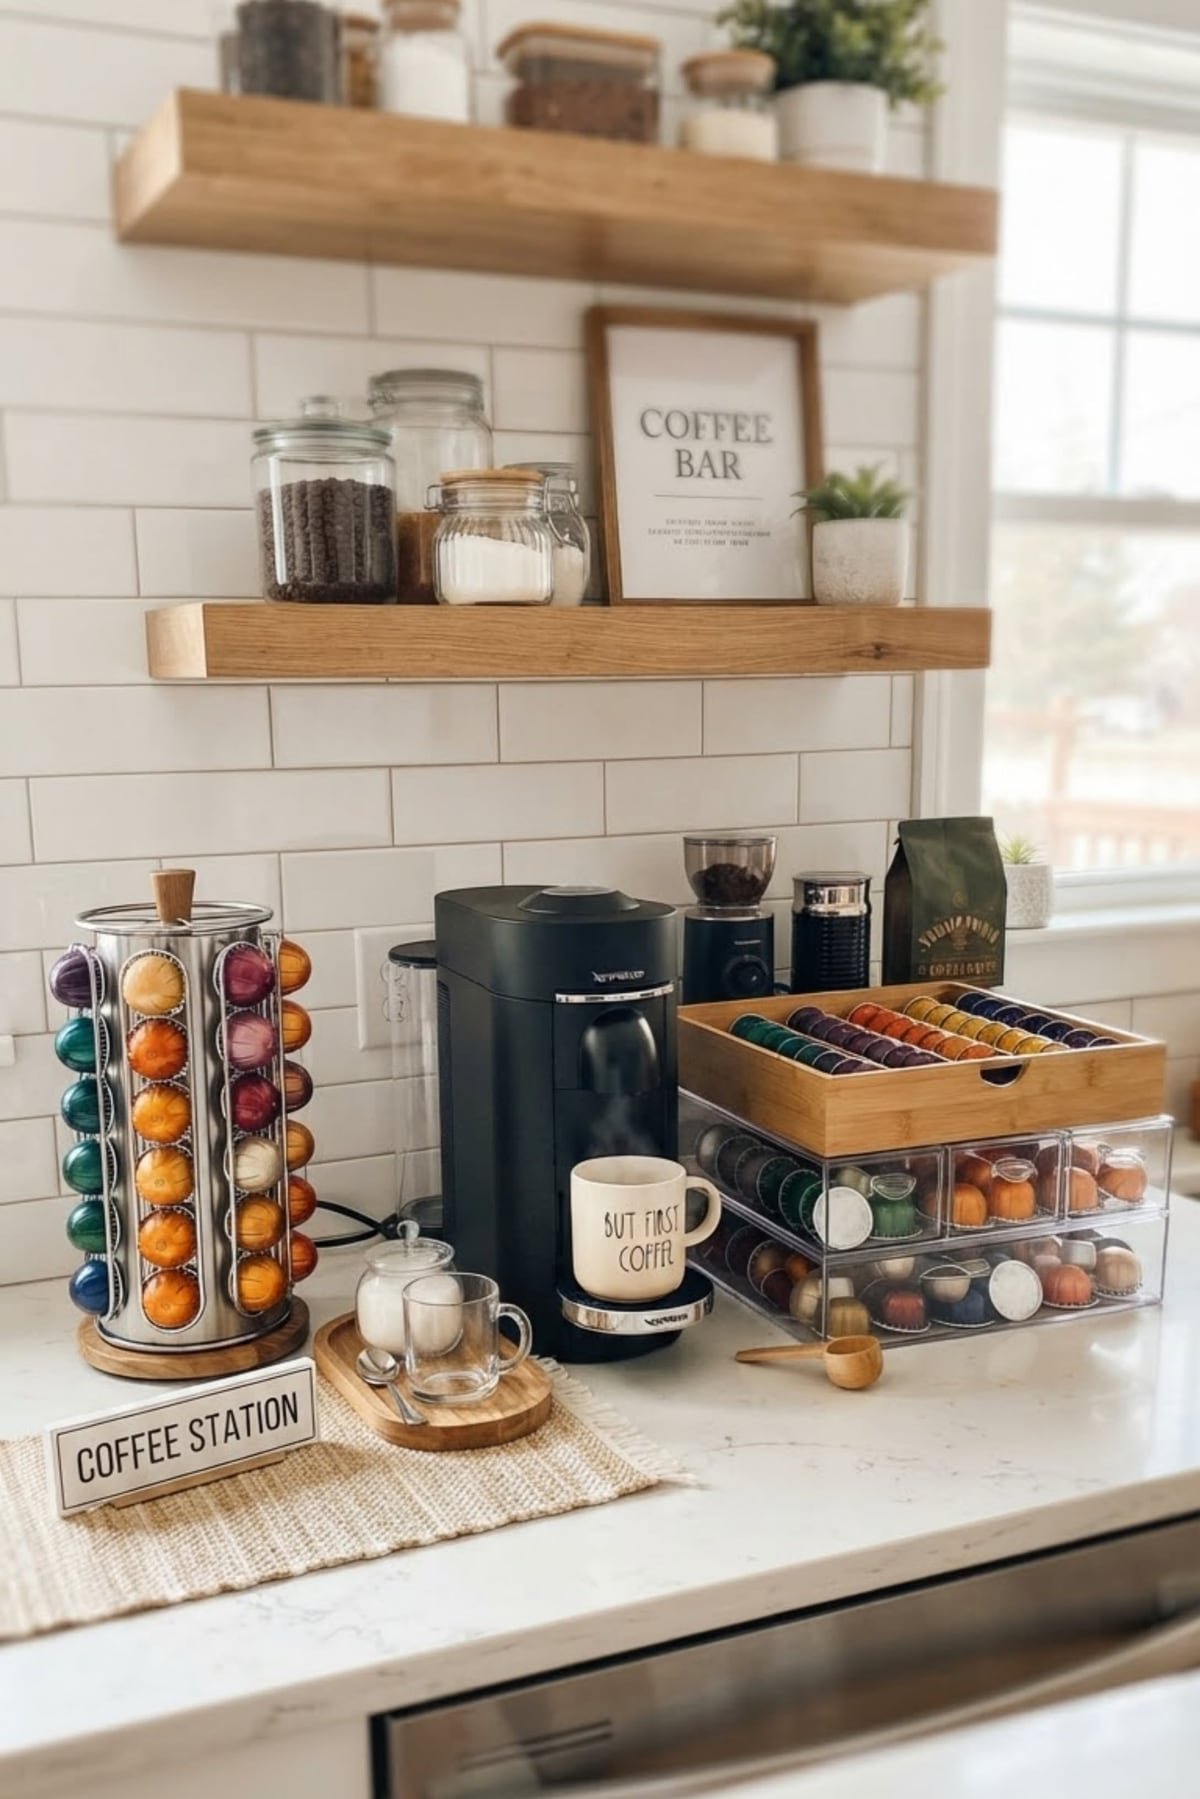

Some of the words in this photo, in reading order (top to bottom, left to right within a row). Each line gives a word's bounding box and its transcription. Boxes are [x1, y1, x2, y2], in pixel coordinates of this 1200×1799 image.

[639, 408, 774, 444] COFFEE
[675, 448, 743, 480] BAR
[604, 1209, 636, 1240] BUT
[645, 1205, 680, 1237] FIRST
[76, 1424, 181, 1484] COFFEE
[188, 1391, 299, 1452] STATION
